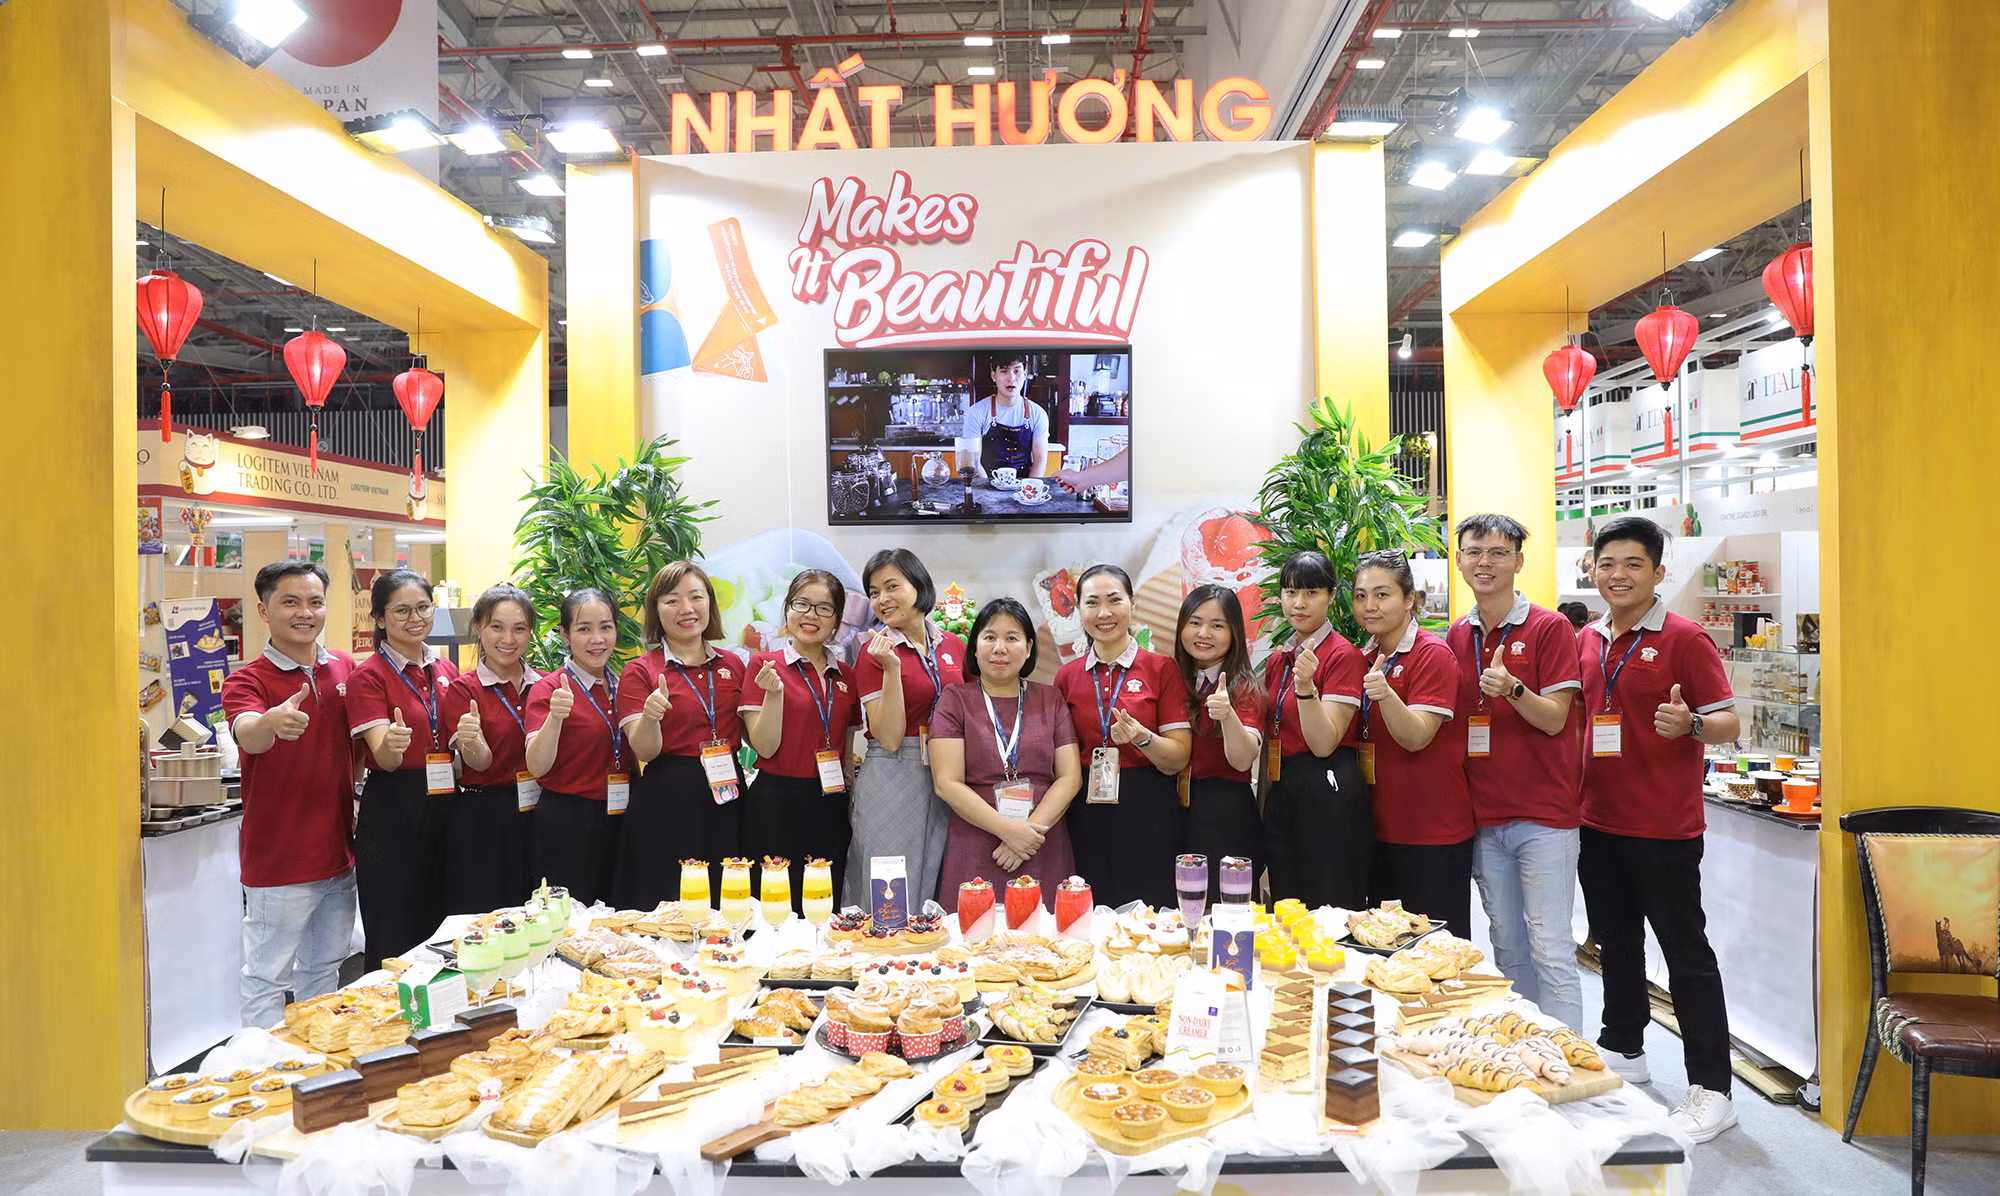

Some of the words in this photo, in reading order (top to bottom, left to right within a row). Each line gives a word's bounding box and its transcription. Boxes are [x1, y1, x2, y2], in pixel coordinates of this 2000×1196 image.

[303, 86, 340, 95] MADE
[346, 84, 360, 94] IN
[323, 98, 368, 112] PAN
[671, 53, 903, 156] NHẤT
[934, 67, 1273, 147] HƯƠNG
[799, 170, 977, 246] Makes
[789, 247, 831, 302] It
[832, 240, 1149, 346] Beautiful
[1764, 364, 1816, 397] ITAL
[237, 452, 290, 476] LOGITEM
[237, 471, 292, 494] TRADING
[294, 480, 316, 497] CO.,
[318, 484, 339, 500] LTD.
[1178, 1014, 1212, 1029] NON-DAIRY
[1179, 1026, 1208, 1039] CREAMER
